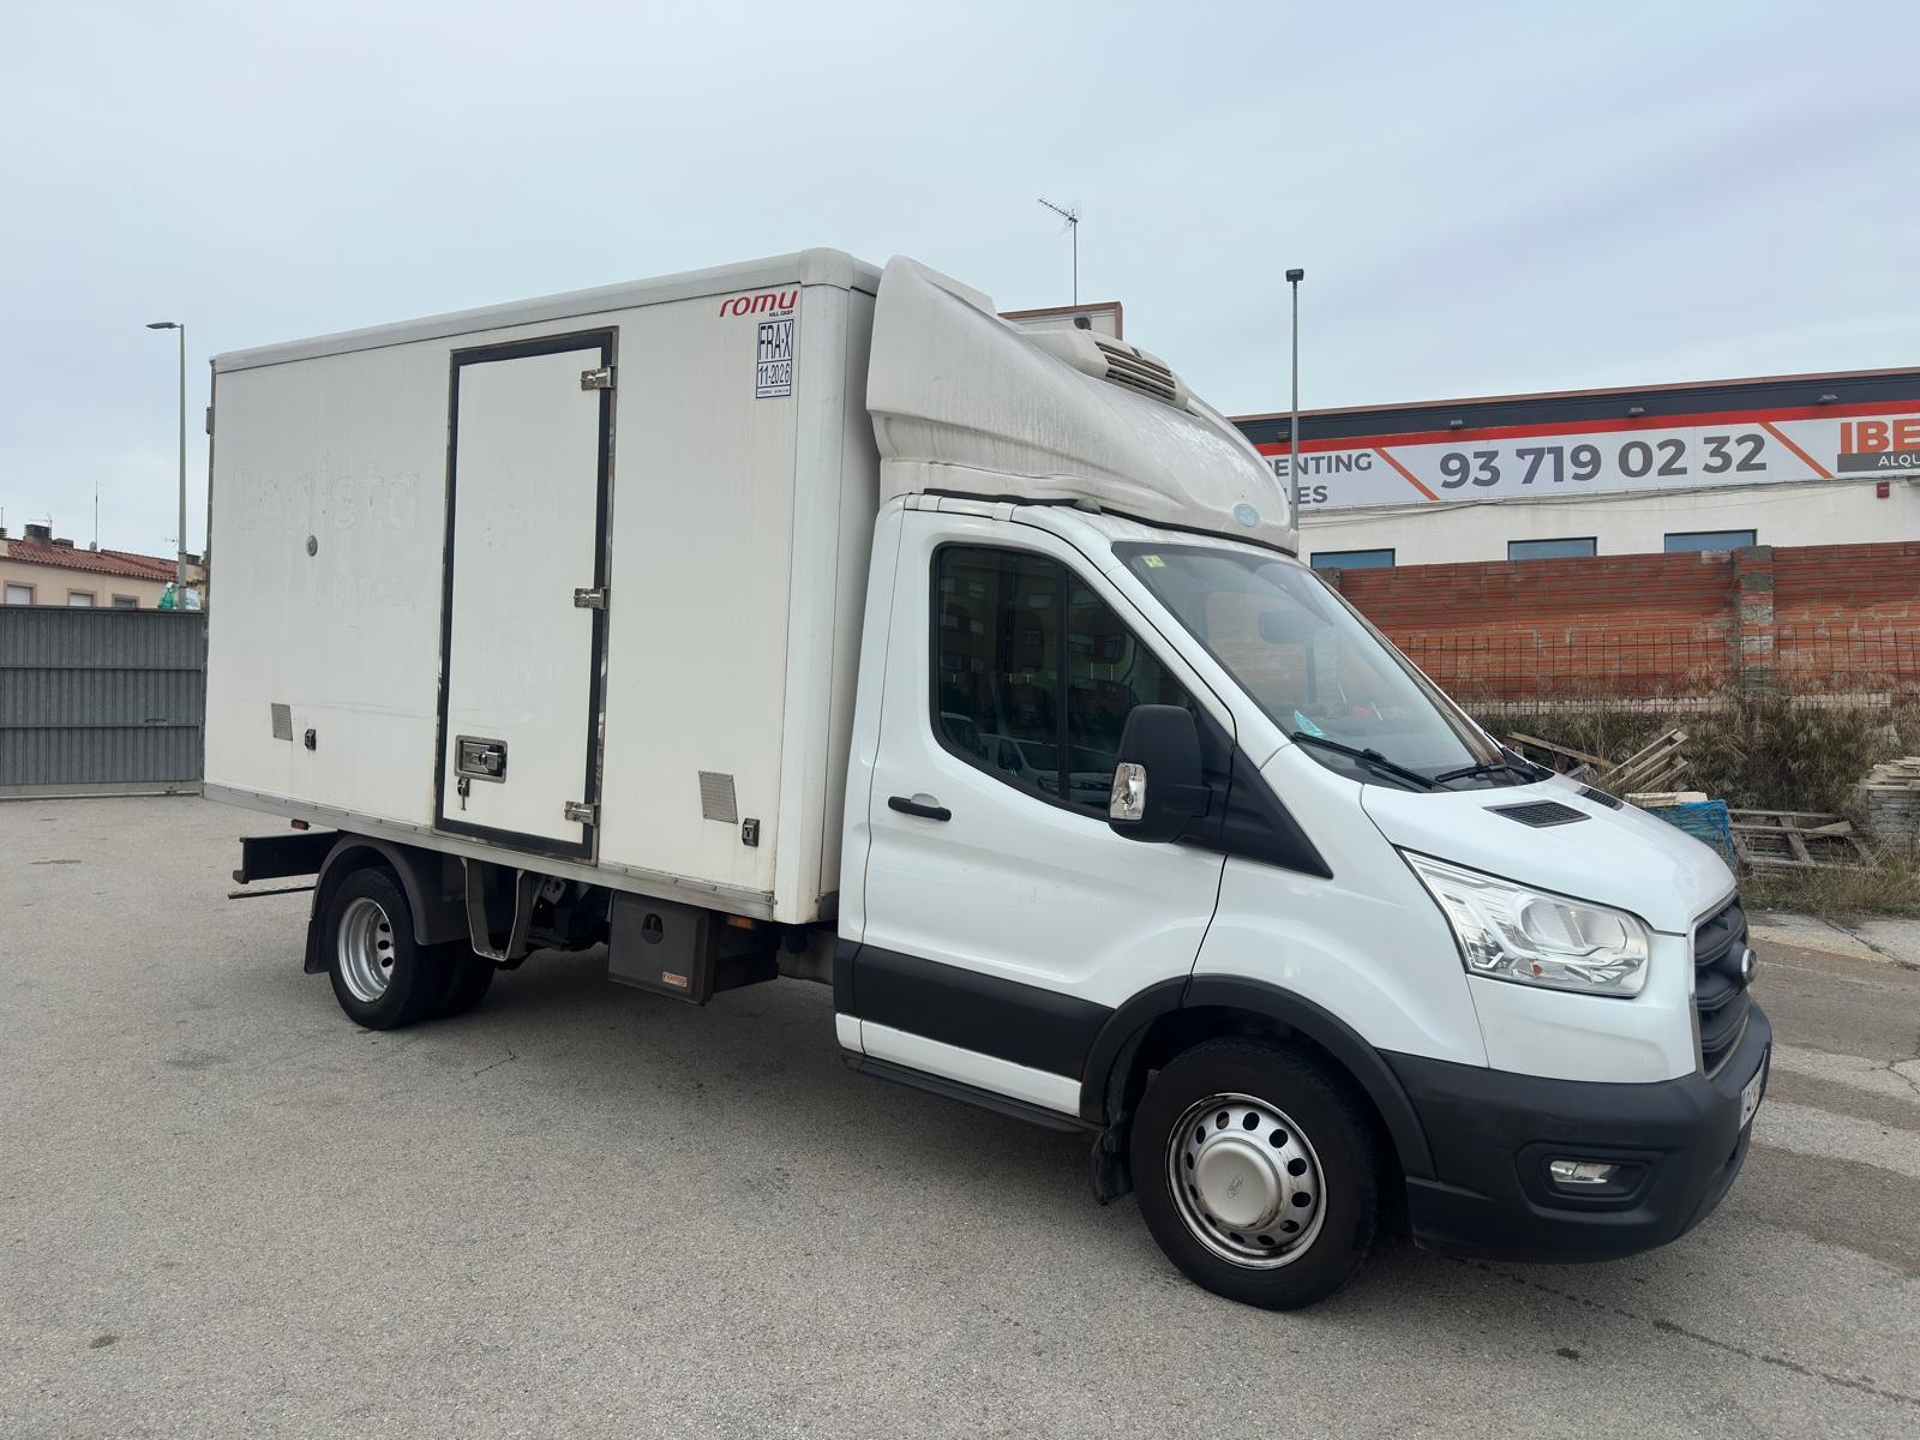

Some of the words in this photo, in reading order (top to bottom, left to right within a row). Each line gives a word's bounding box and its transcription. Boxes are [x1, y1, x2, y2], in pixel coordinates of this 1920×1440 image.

[719, 290, 798, 318] romu
[758, 363, 791, 386] 11-2026
[1840, 418, 1920, 454] IBE
[1439, 450, 1501, 489] 93
[1515, 443, 1602, 484] 719
[1618, 438, 1688, 478] 02
[1702, 433, 1767, 474] 32
